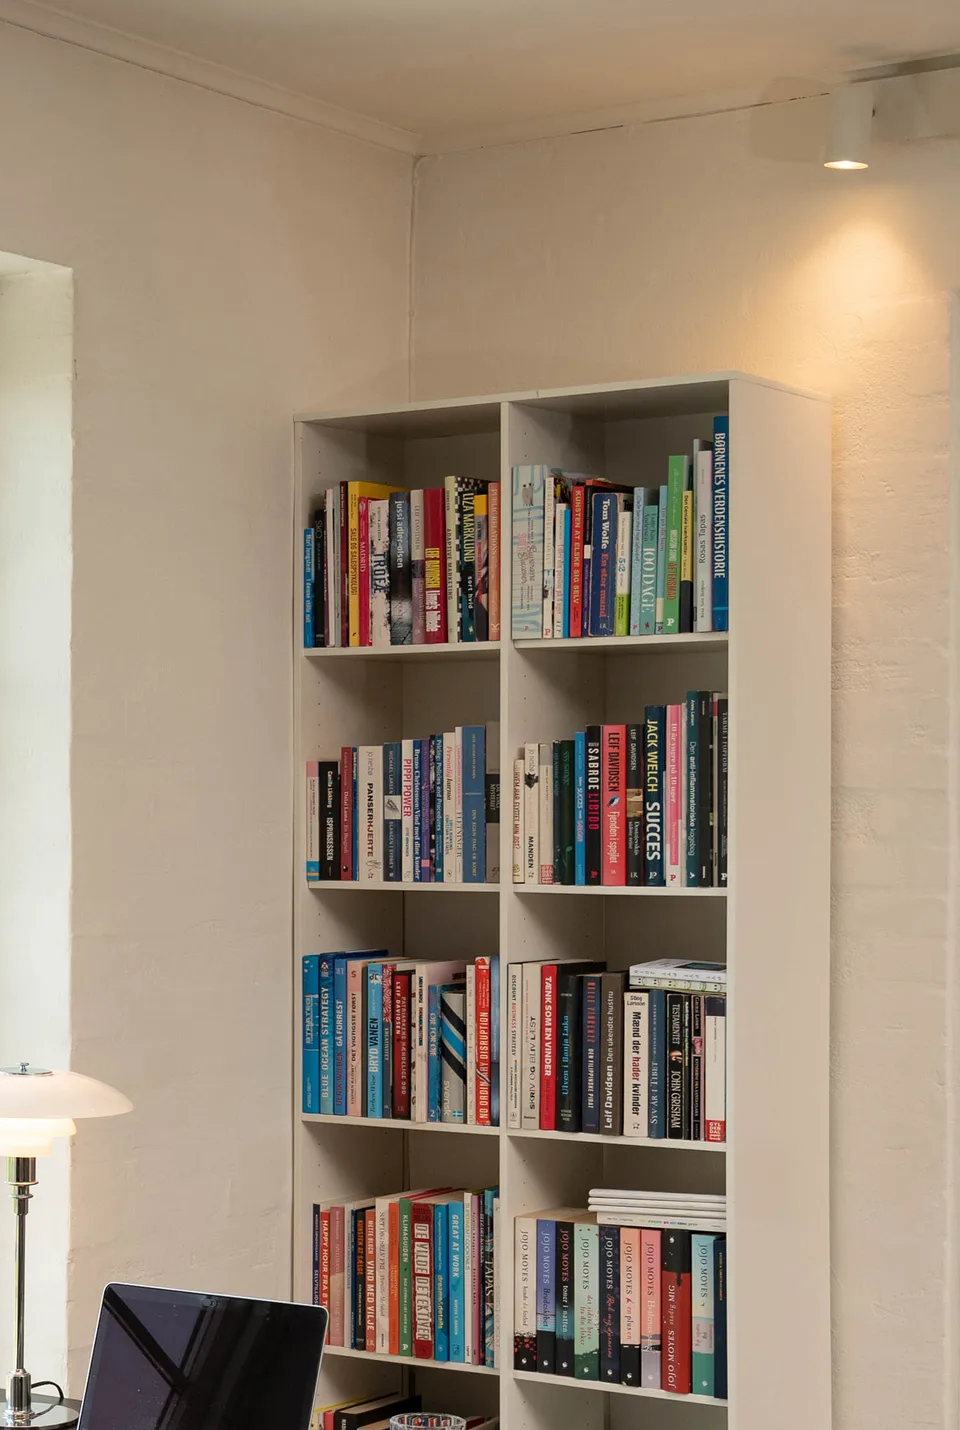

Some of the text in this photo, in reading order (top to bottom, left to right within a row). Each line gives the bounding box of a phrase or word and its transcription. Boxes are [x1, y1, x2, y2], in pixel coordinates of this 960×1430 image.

[602, 499, 610, 521] Tom
[714, 433, 726, 579] BØRNENES VERDENSHISTORIE
[350, 528, 358, 542] SALG
[395, 500, 404, 569] jussi adler-olsen
[462, 492, 475, 562] LIZA MARKLUND
[574, 530, 580, 540] AT
[601, 522, 609, 550] Wolfe
[699, 514, 707, 537] Tapas
[425, 548, 440, 559] LEIF
[601, 553, 608, 567] En
[350, 551, 358, 596] SALGSPSYKOLOGI
[373, 552, 387, 594] TROFÆ
[425, 560, 440, 588] DAVIDSEN
[641, 547, 655, 613] 100 DAGE
[608, 732, 620, 750] LEIF
[608, 752, 620, 792] DAVIDSEN
[403, 758, 411, 817] PIPPI POWER
[588, 748, 599, 830] SABROE LIBIDO
[646, 719, 661, 861] JACK WELCH SUCCES
[608, 810, 620, 836] Fjenden
[607, 841, 619, 863] spejlet
[688, 828, 696, 856] kogebog
[544, 976, 552, 1003] TÆNK
[544, 1005, 552, 1026] SOM
[561, 1015, 569, 1037] Luka
[321, 986, 329, 1098] BLUE OCEAN STRATEGY
[335, 1035, 343, 1047] GÅ
[480, 1011, 489, 1059] DISRUPTION
[544, 1027, 552, 1040] EN
[544, 1041, 552, 1077] VINDER
[561, 1038, 569, 1063] Banja
[529, 1066, 536, 1081] OG
[631, 1011, 641, 1116] Mænd der hader kvinder
[671, 1004, 681, 1128] TESTAMENTET JOHN GRISHAM
[335, 1083, 343, 1107] ULRIK
[480, 1061, 489, 1106] ORDINARY
[561, 1070, 569, 1095] Ulven
[605, 1065, 613, 1109] Davidsen
[443, 1080, 451, 1116] svensk
[480, 1108, 489, 1119] NO
[605, 1110, 613, 1129] Leif
[451, 1214, 459, 1278] GREAT AT WORK
[541, 1232, 550, 1253] JOJO
[560, 1229, 569, 1251] JOJO
[605, 1236, 613, 1257] JOJO
[623, 1241, 633, 1263] JOJO
[581, 1237, 590, 1290] JOJO MOYES
[645, 1242, 654, 1264] JOJO
[415, 1225, 431, 1340] DE VILDE DETEKTIVER
[485, 1257, 494, 1294] TAPAS
[698, 1243, 708, 1298] JOJO MOYES
[667, 1284, 675, 1302] MIG
[624, 1315, 633, 1331] plus
[627, 1306, 632, 1315] en
[627, 1331, 632, 1340] en
[667, 1364, 676, 1388] JOJO
